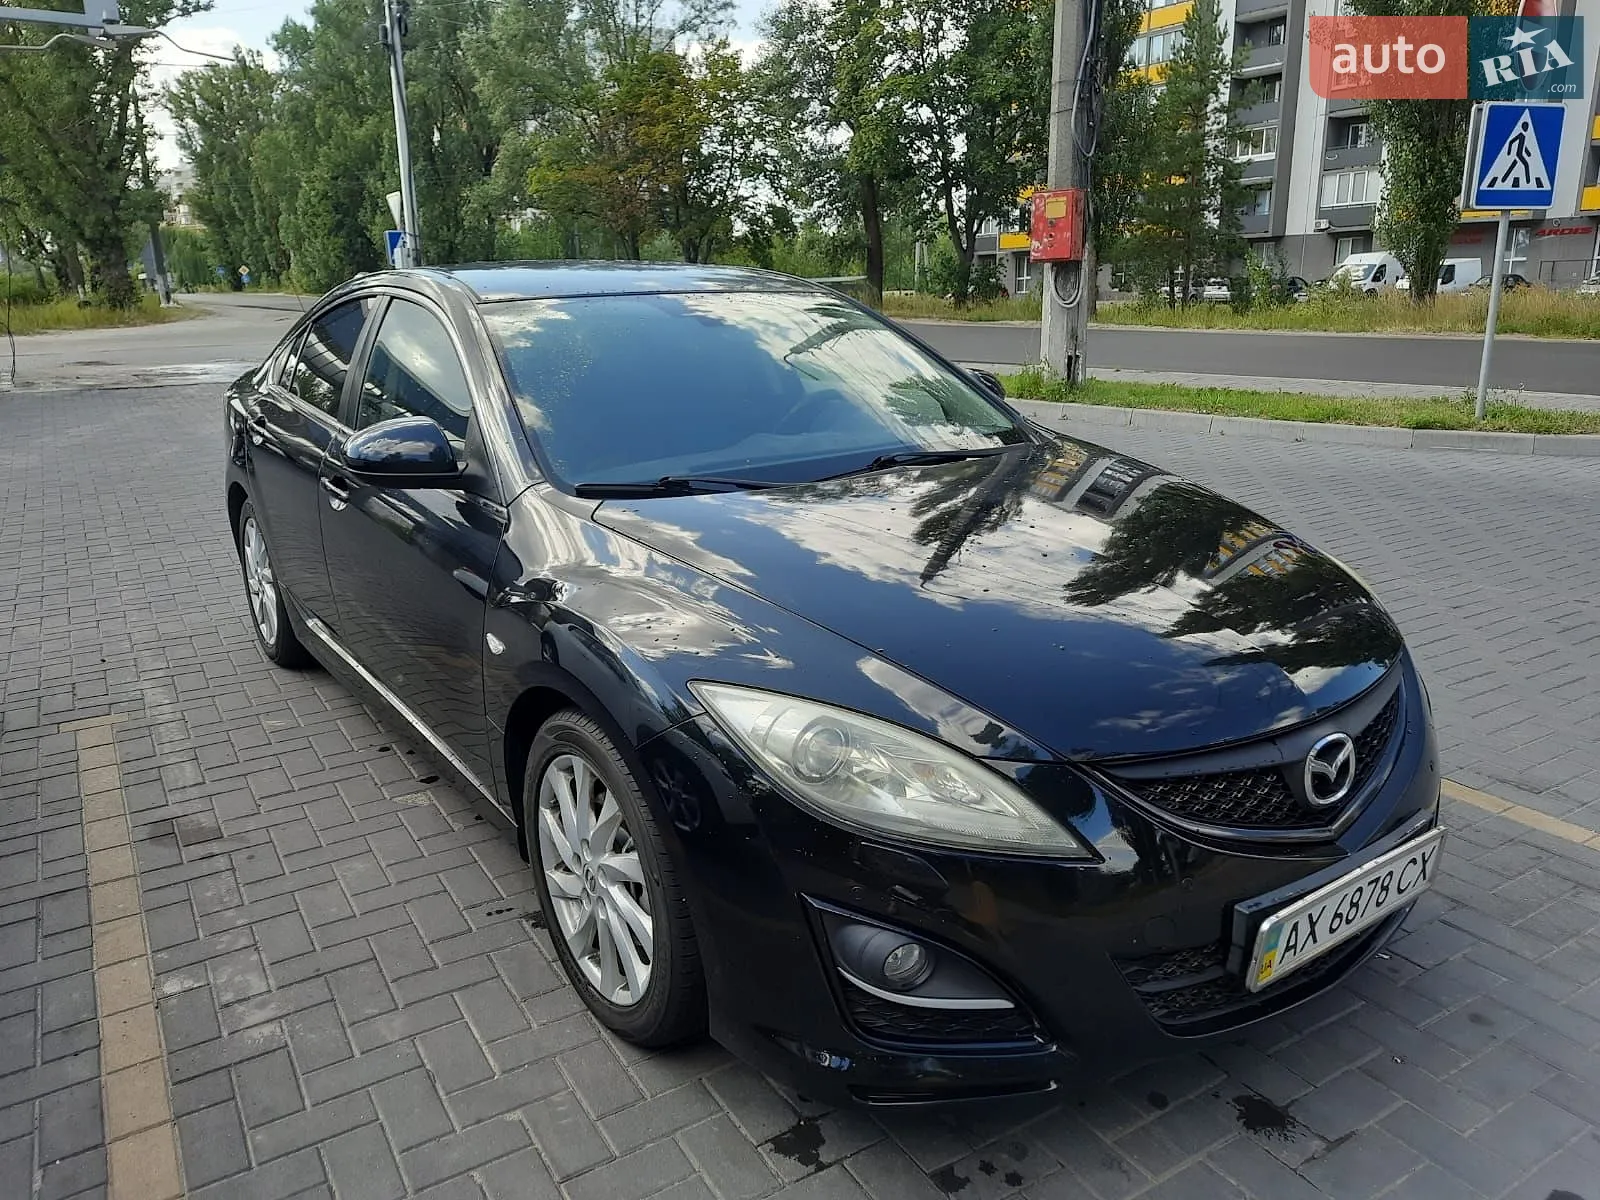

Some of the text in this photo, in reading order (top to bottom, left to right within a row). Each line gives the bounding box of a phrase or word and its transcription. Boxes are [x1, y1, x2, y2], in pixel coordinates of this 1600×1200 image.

[1278, 845, 1437, 965] AX 6878 CX
